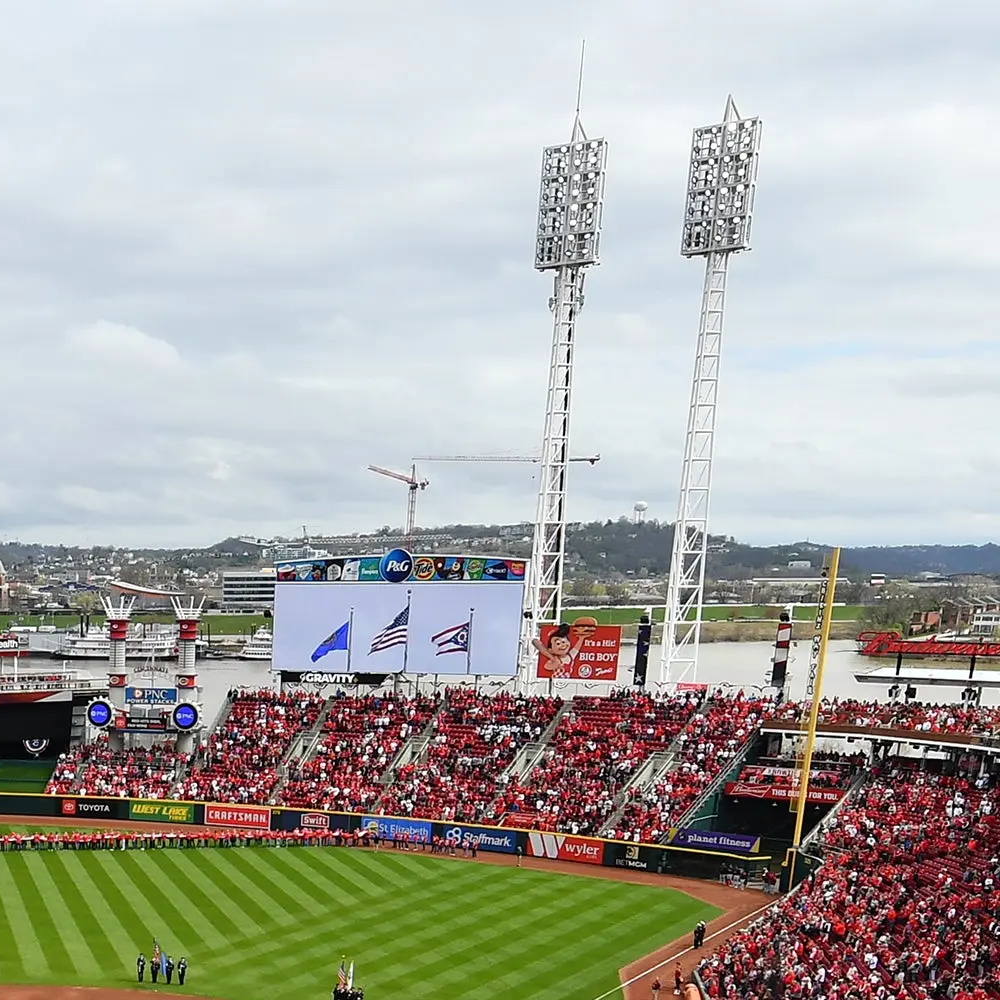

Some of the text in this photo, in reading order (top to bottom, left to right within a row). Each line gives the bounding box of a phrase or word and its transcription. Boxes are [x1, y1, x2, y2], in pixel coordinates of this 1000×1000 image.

[386, 560, 409, 572] P&G
[415, 562, 433, 576] Tide
[579, 653, 616, 662] BIG BOY
[306, 673, 355, 683] GRAVITY
[144, 690, 169, 699] PNC
[772, 789, 787, 797] THIS
[808, 791, 823, 799] FOR
[78, 803, 111, 813] TOYOTA
[132, 803, 189, 816] WEST LAKE
[208, 810, 267, 823] CRAFTSMAN
[303, 816, 327, 825] Swift
[390, 824, 429, 837] Elizabeth
[463, 831, 512, 847] Staffmark
[687, 833, 751, 848] planet fitness
[564, 842, 600, 857] wyler
[615, 859, 648, 869] BETMGM
